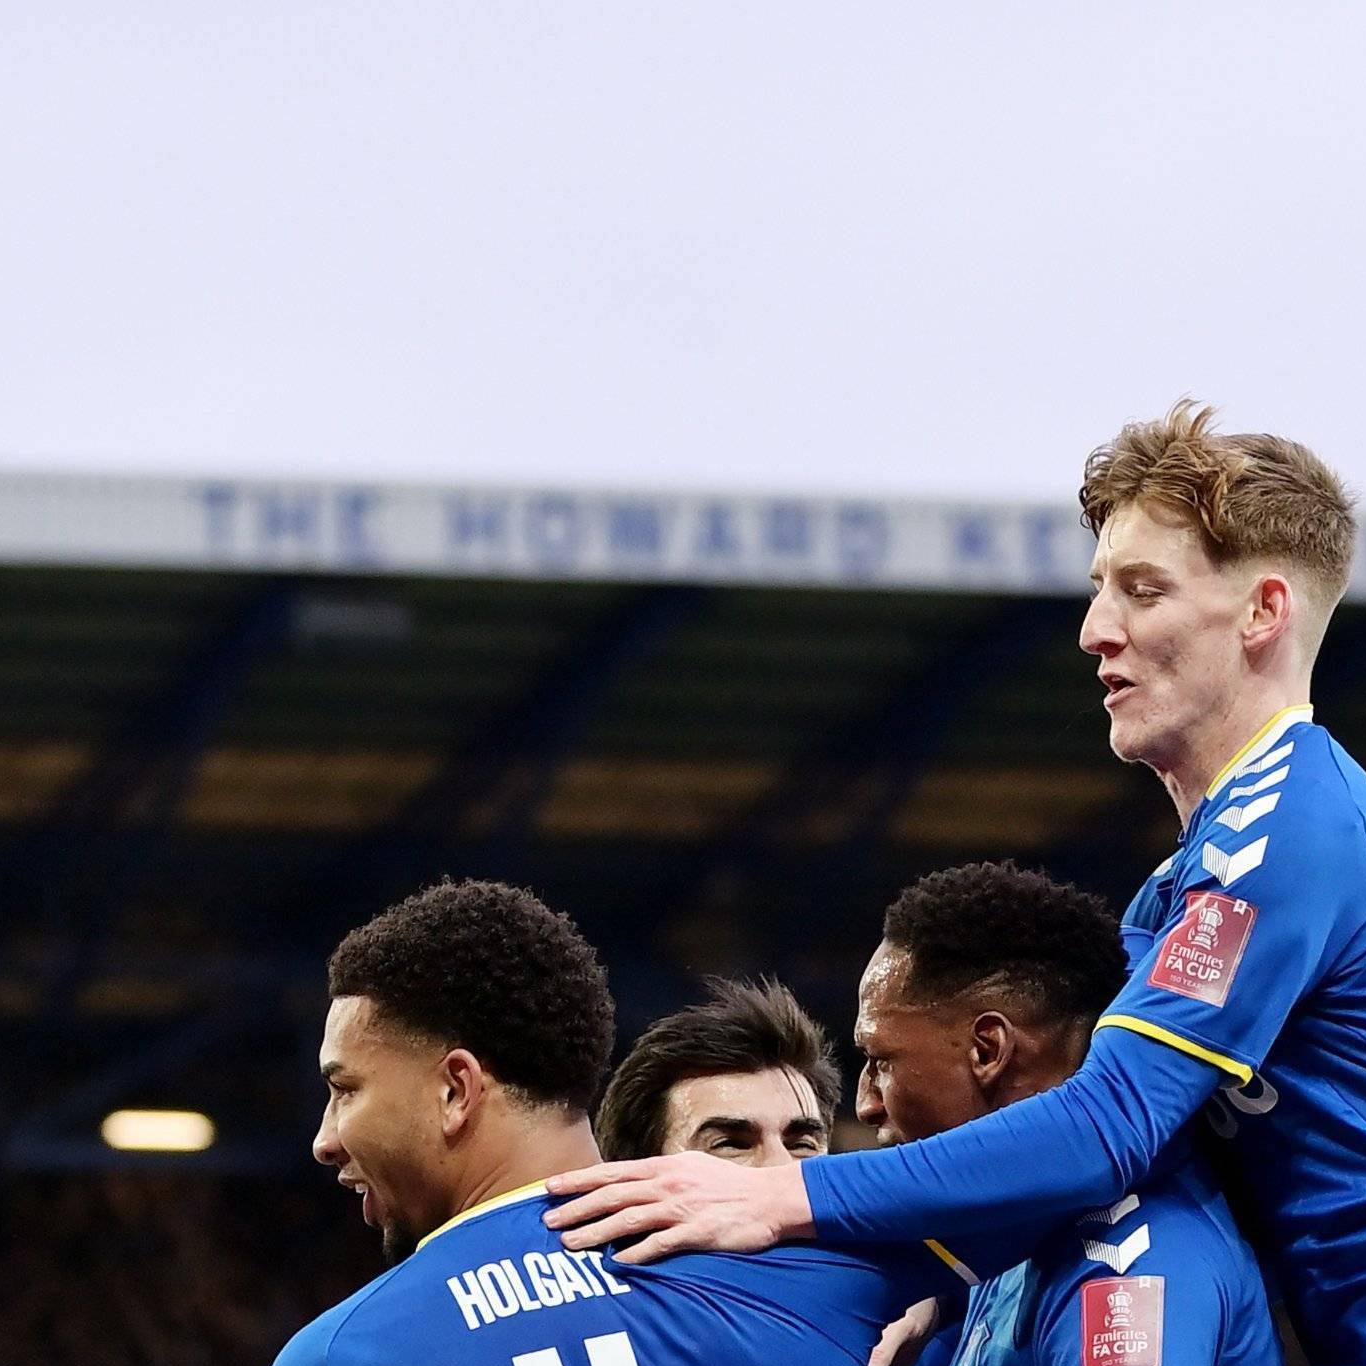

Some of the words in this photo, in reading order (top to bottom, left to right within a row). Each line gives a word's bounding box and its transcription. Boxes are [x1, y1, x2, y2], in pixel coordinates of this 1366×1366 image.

[1165, 955, 1183, 973] FA
[1186, 961, 1221, 982] CUP
[1170, 942, 1225, 970] Emirates
[446, 1249, 633, 1331] HOLGATE
[1092, 1328, 1148, 1346] Emirates
[1092, 1343, 1111, 1359] FA
[1113, 1340, 1148, 1355] CUP
